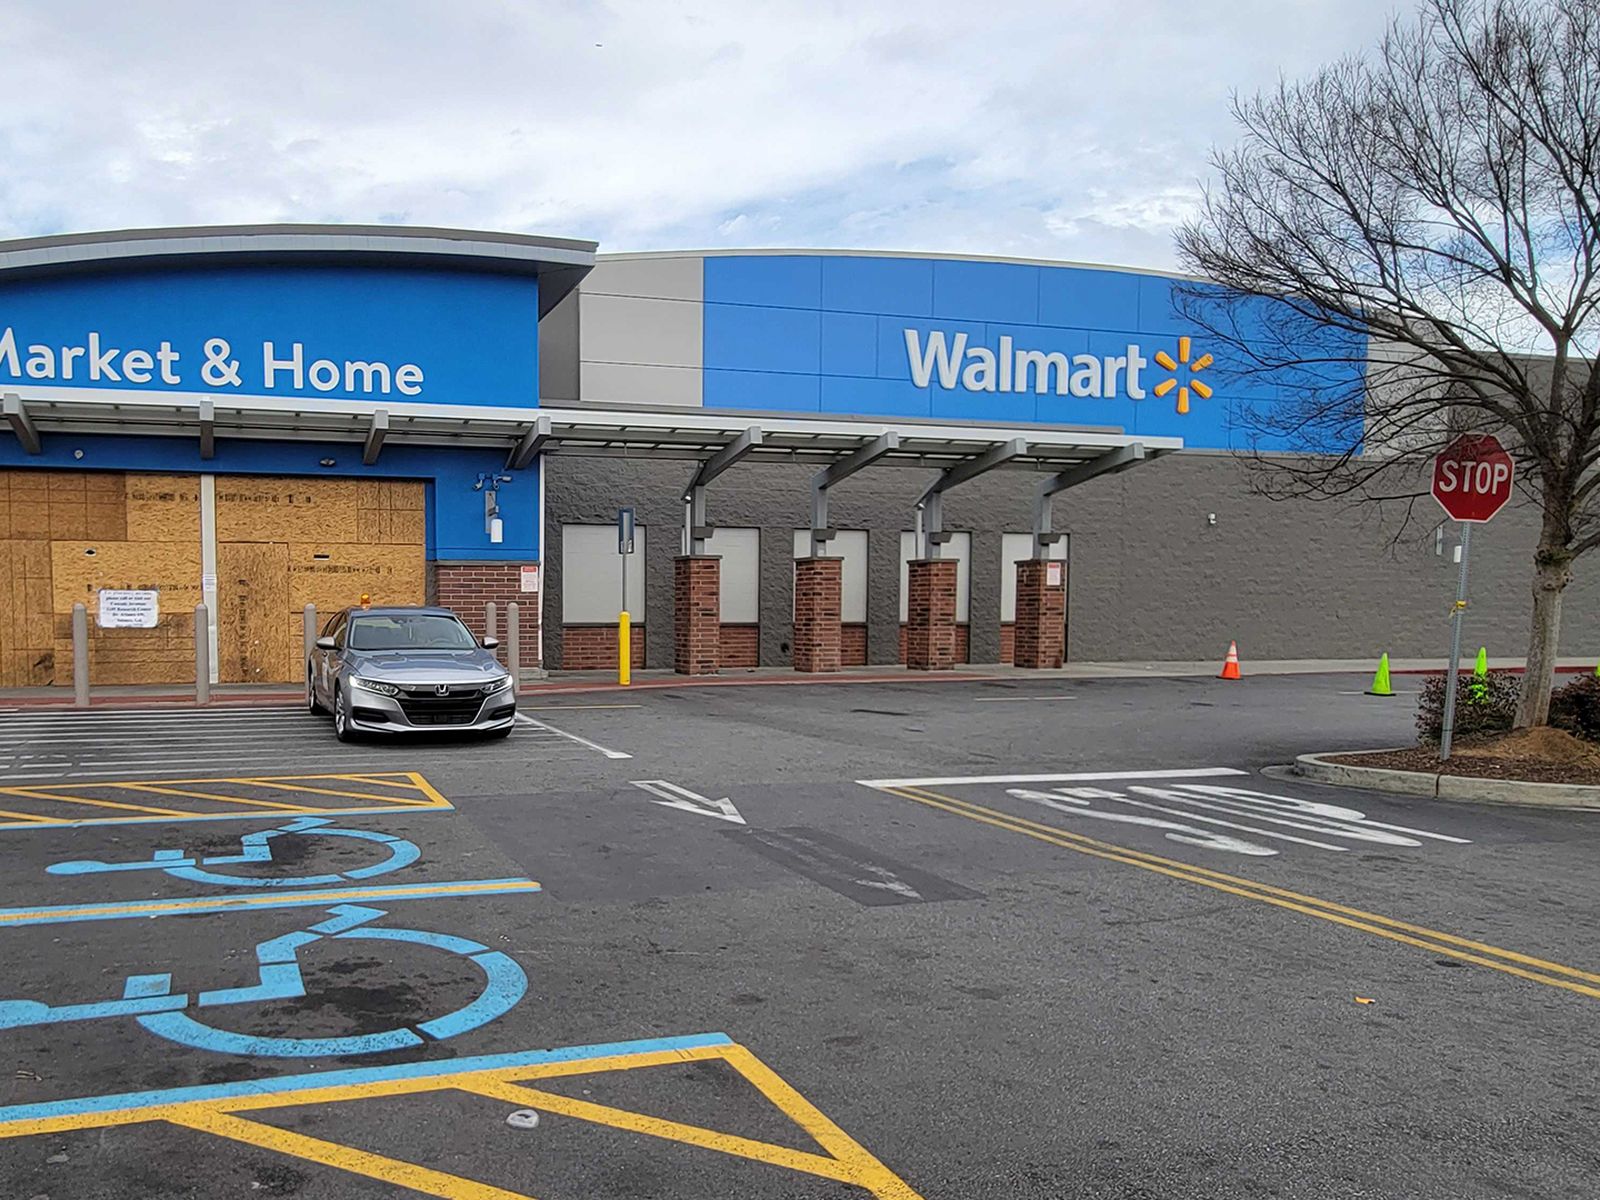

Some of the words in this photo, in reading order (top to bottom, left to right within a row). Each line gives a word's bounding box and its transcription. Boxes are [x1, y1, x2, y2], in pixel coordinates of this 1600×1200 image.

[201, 337, 242, 387] &
[263, 341, 425, 395] Home
[903, 328, 1147, 400] Walmart
[1438, 459, 1509, 495] STOP
[1005, 783, 1474, 857] STOP
